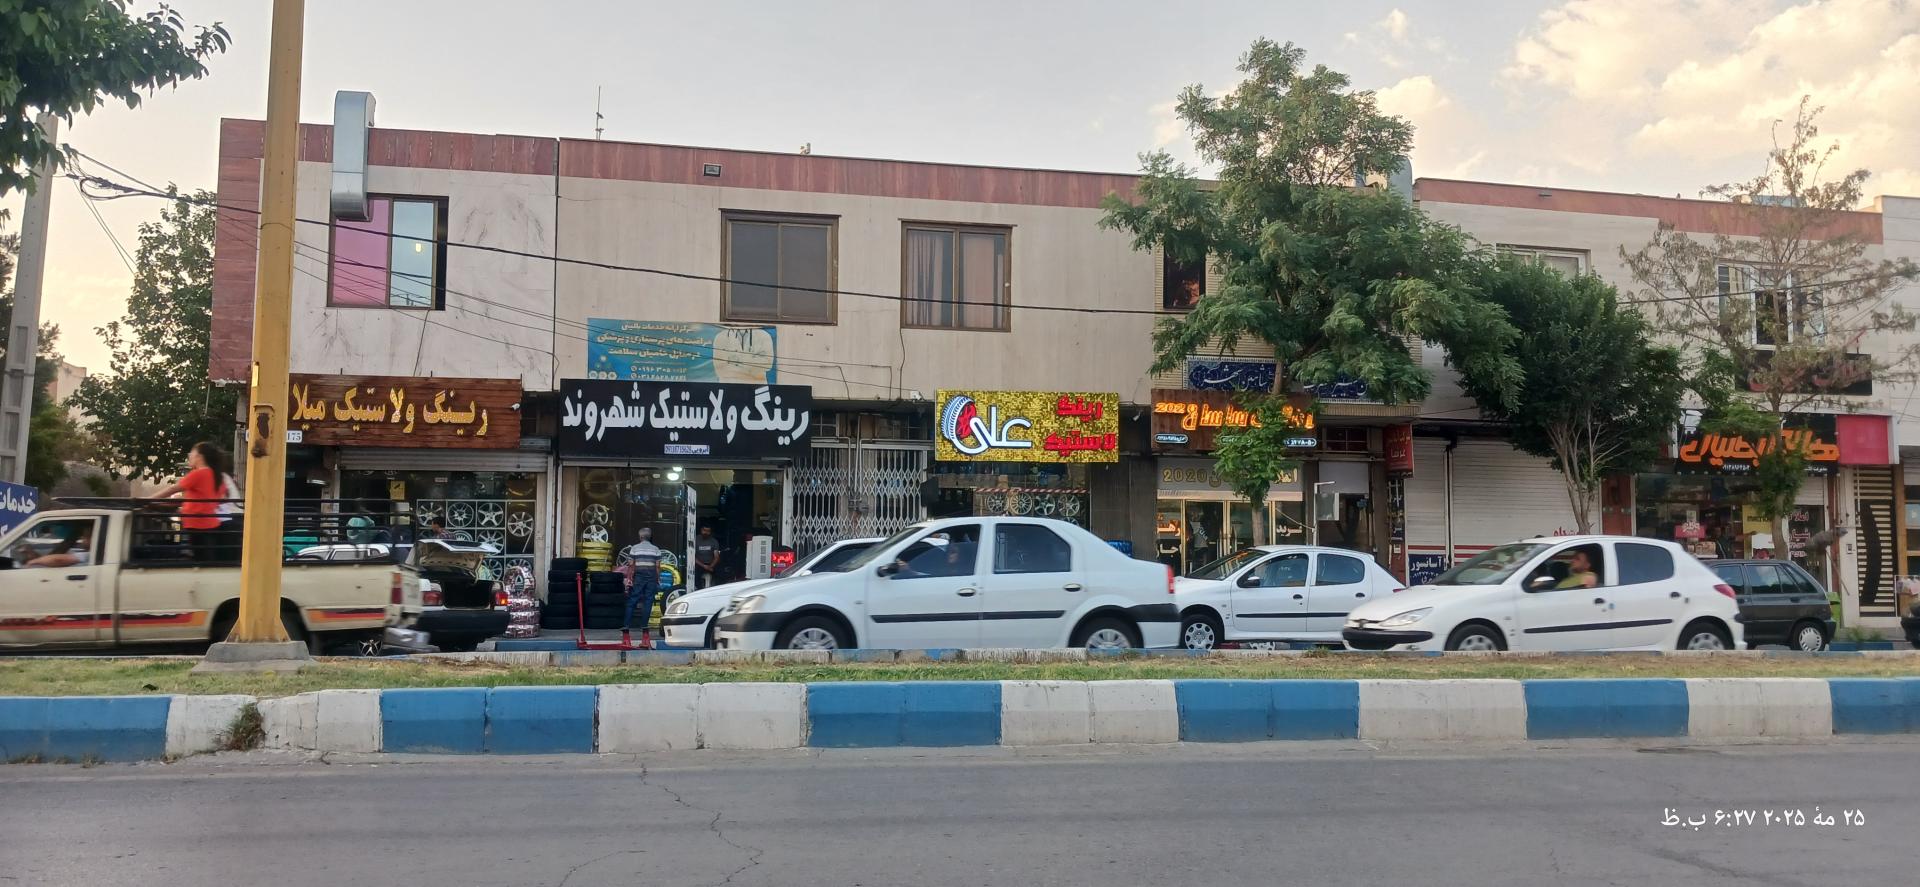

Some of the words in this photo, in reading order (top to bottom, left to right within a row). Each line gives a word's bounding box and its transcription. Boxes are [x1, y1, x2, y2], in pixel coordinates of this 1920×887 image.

[292, 382, 326, 431] میلا
[422, 387, 489, 437] رینگ
[563, 381, 645, 441] شهروند
[741, 385, 809, 446] رینگ
[1057, 394, 1104, 422] رینگ
[1044, 430, 1117, 457] لاستیک
[1162, 467, 1208, 484] 2020
[1410, 555, 1443, 572] آسانسور
